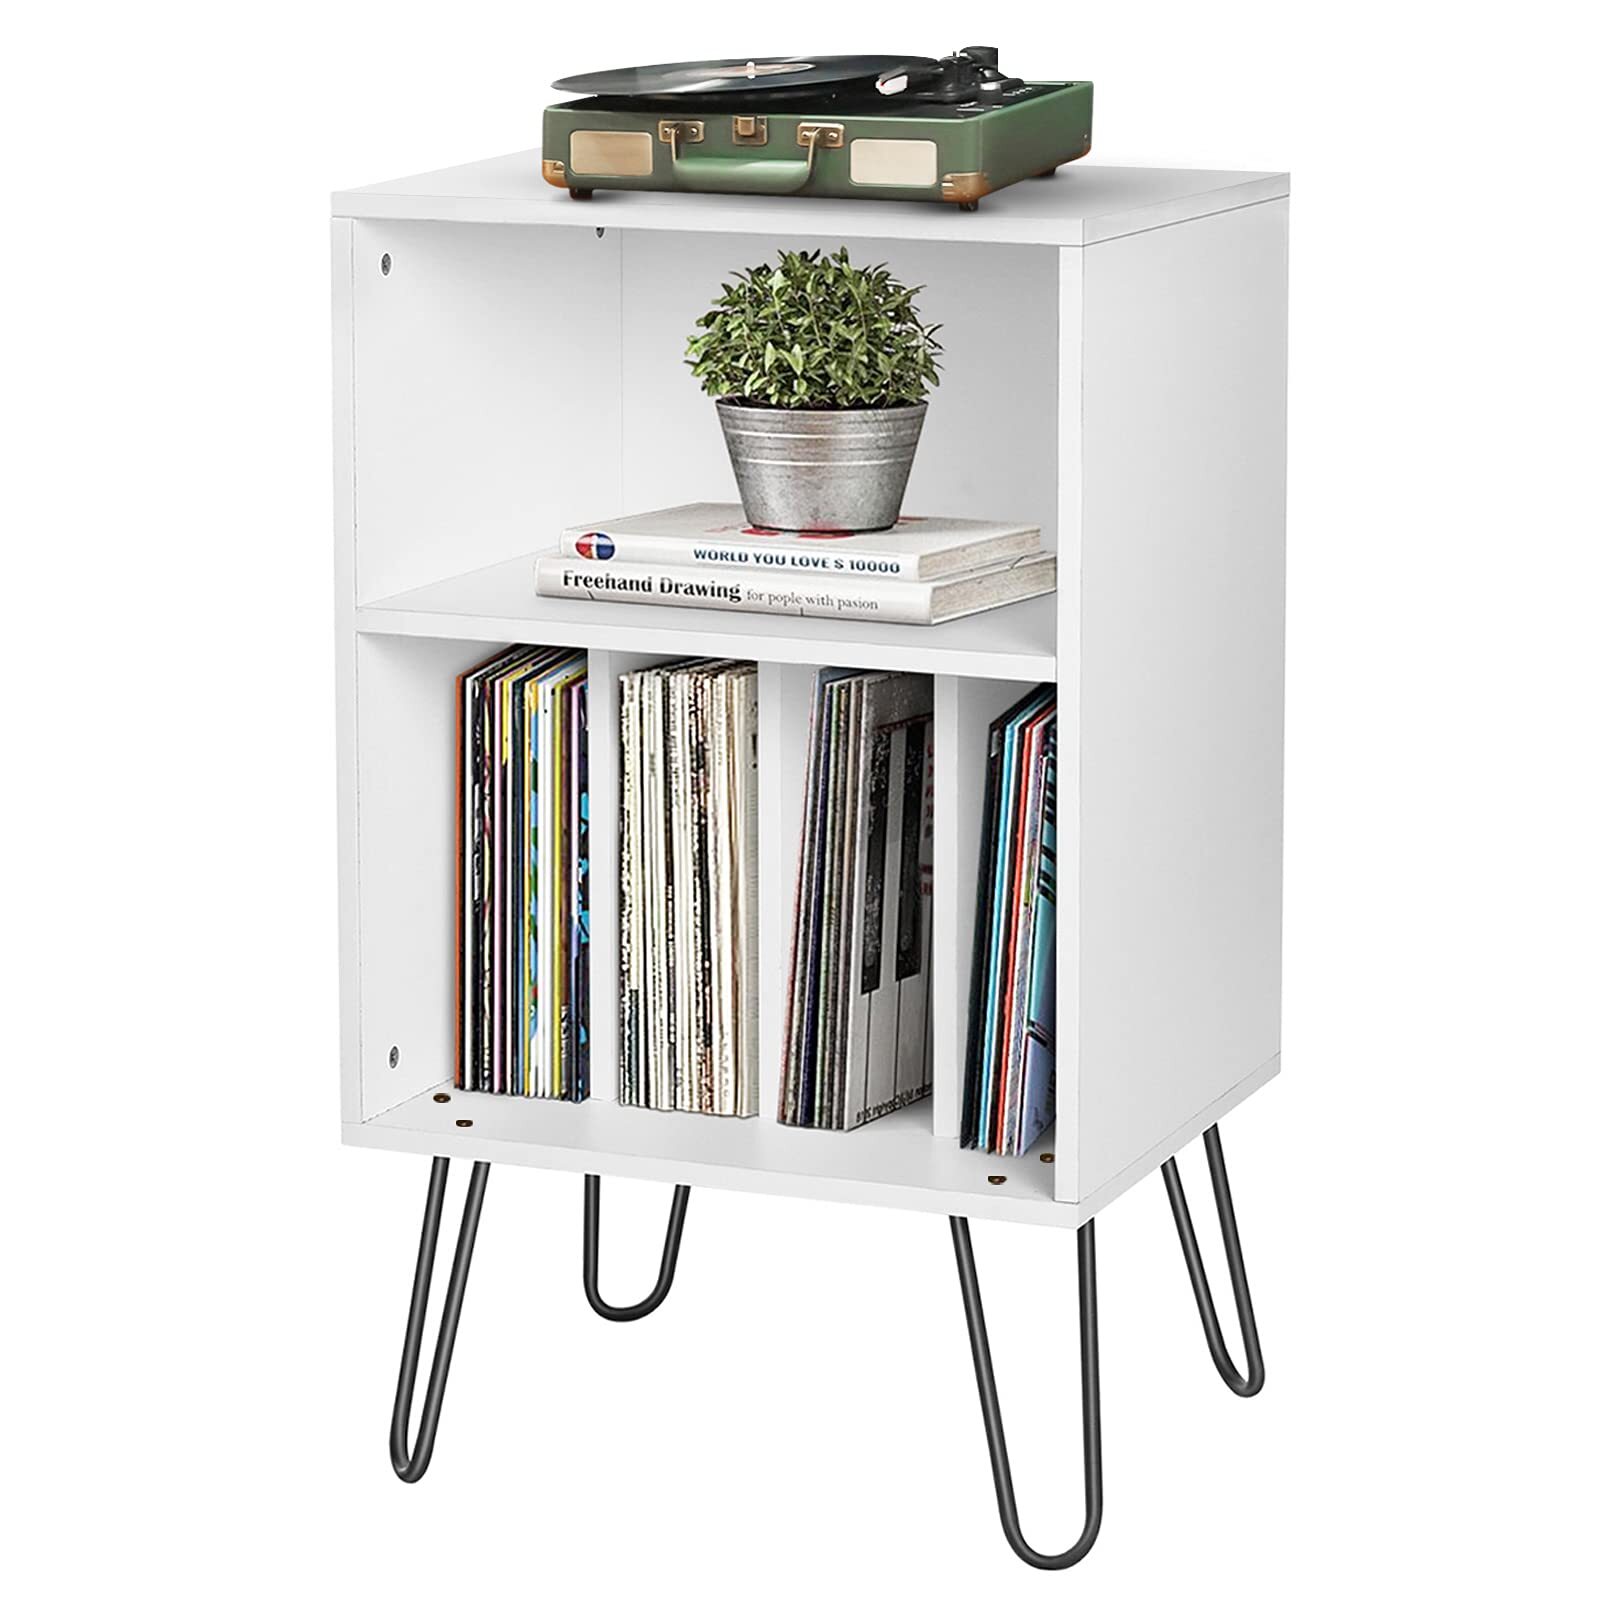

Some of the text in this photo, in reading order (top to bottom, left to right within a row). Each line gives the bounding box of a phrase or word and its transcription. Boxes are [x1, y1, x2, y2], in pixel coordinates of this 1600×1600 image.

[693, 549, 749, 563] WORLD
[753, 552, 786, 566] YOU
[791, 555, 830, 569] LOVE
[849, 559, 901, 574] 10000
[563, 570, 879, 611] Freehand Drawing for pople with pasion
